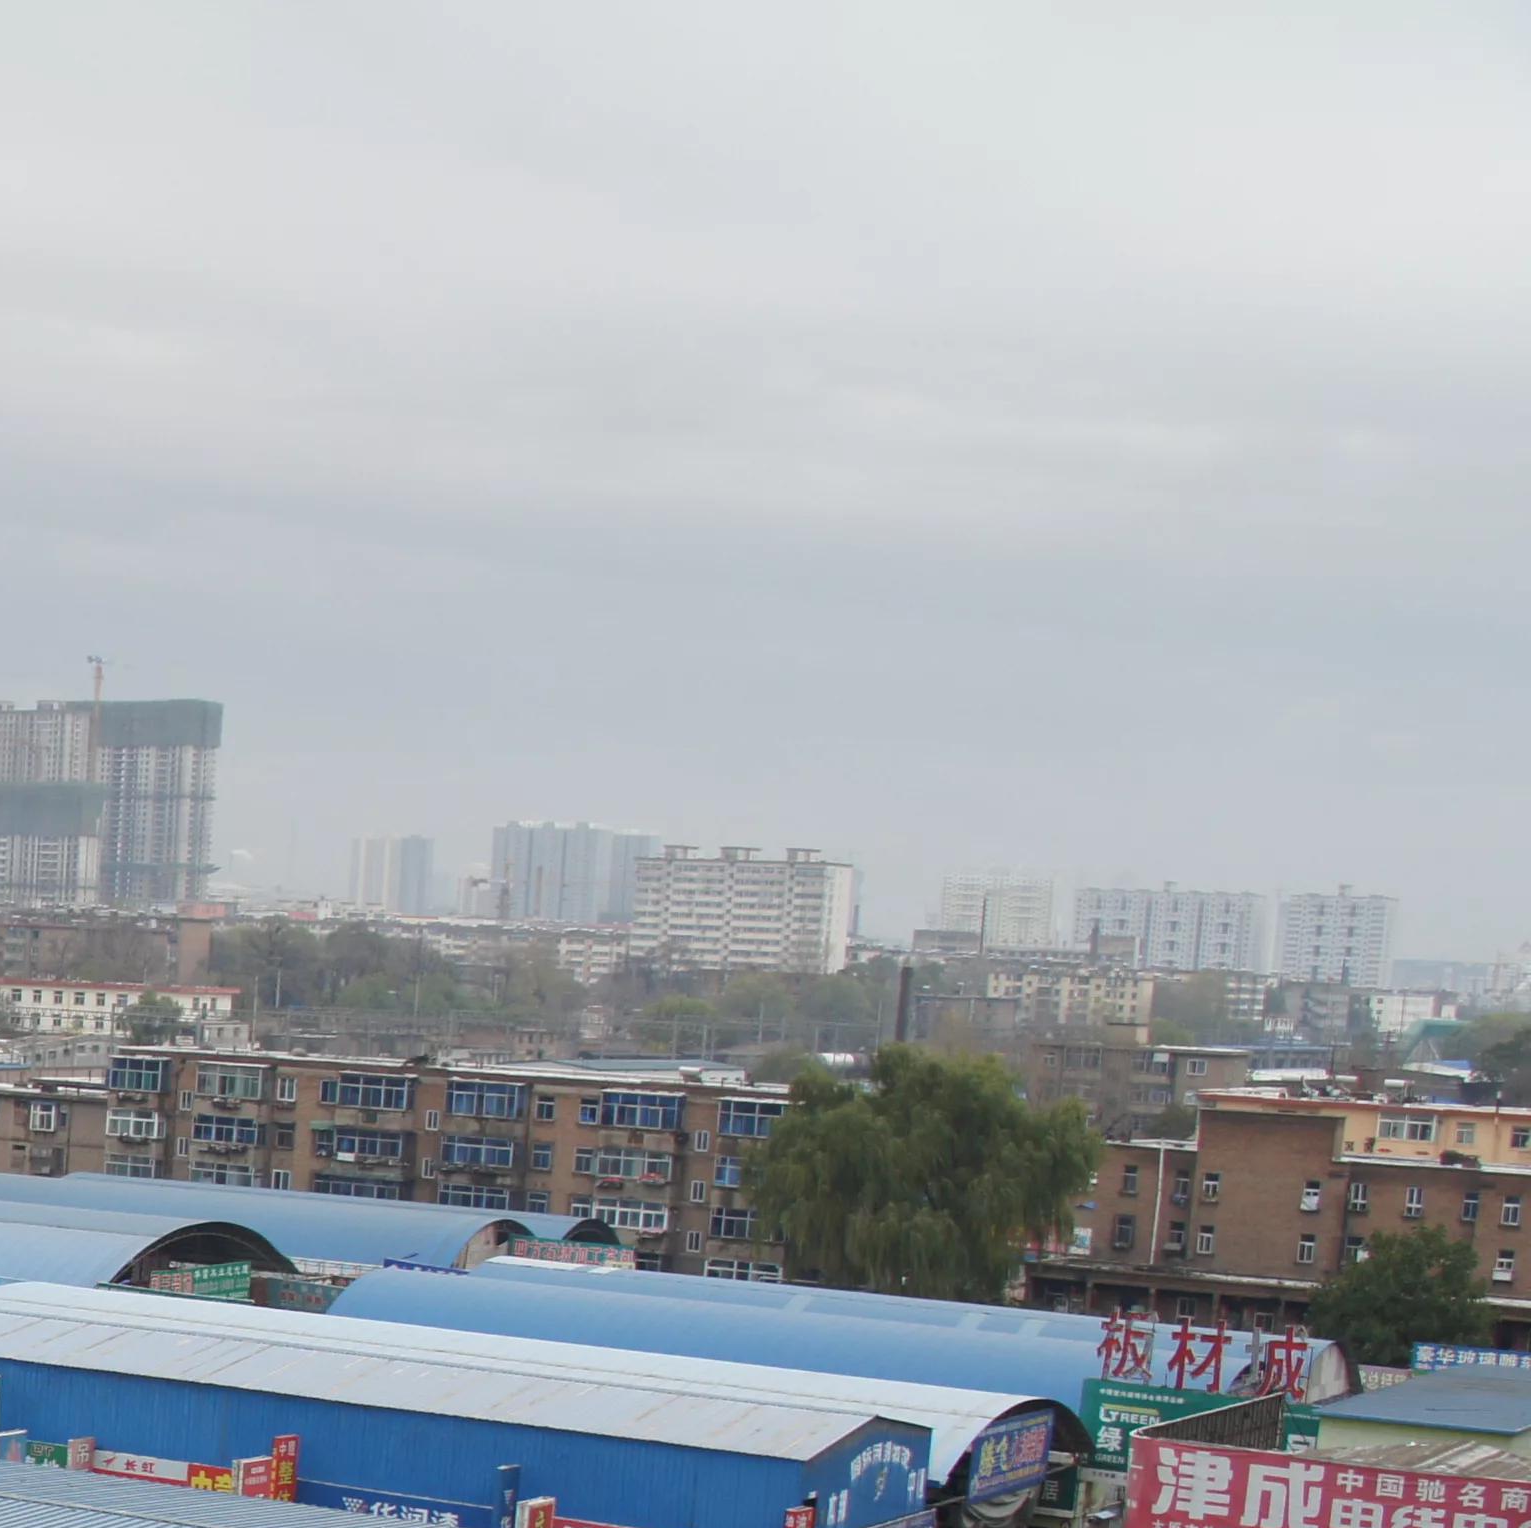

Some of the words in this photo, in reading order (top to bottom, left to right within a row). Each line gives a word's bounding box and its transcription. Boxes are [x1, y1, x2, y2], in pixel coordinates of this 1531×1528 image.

[1096, 1306, 1309, 1400] 板材城
[123, 1458, 157, 1476] 长虹
